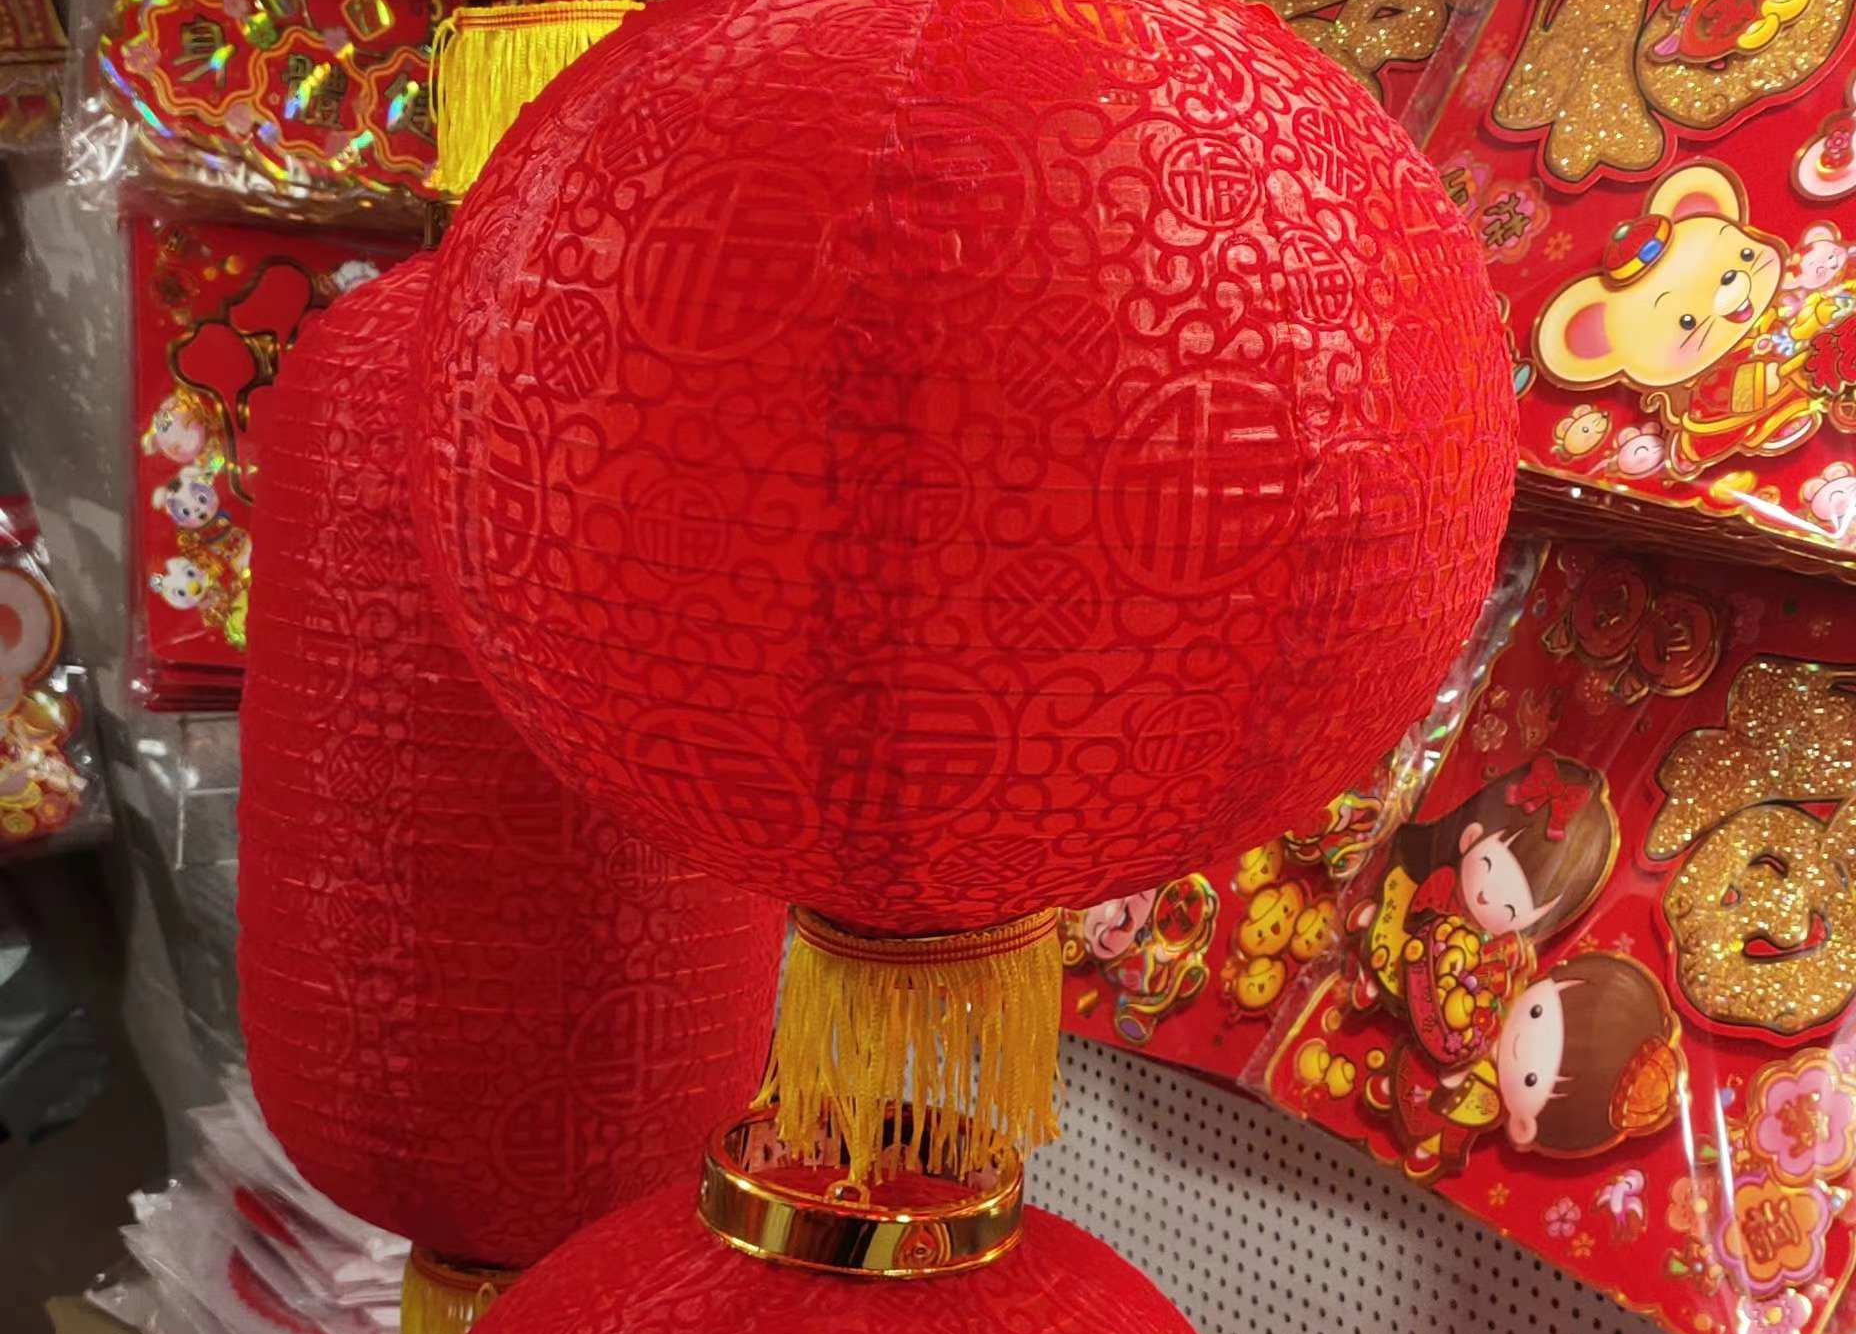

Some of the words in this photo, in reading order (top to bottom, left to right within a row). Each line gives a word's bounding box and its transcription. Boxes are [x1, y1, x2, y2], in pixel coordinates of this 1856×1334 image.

[1162, 135, 1262, 229] 福
[624, 161, 831, 360] 福
[1280, 228, 1352, 328] 福
[632, 475, 729, 584] 福
[1100, 370, 1302, 599] 福
